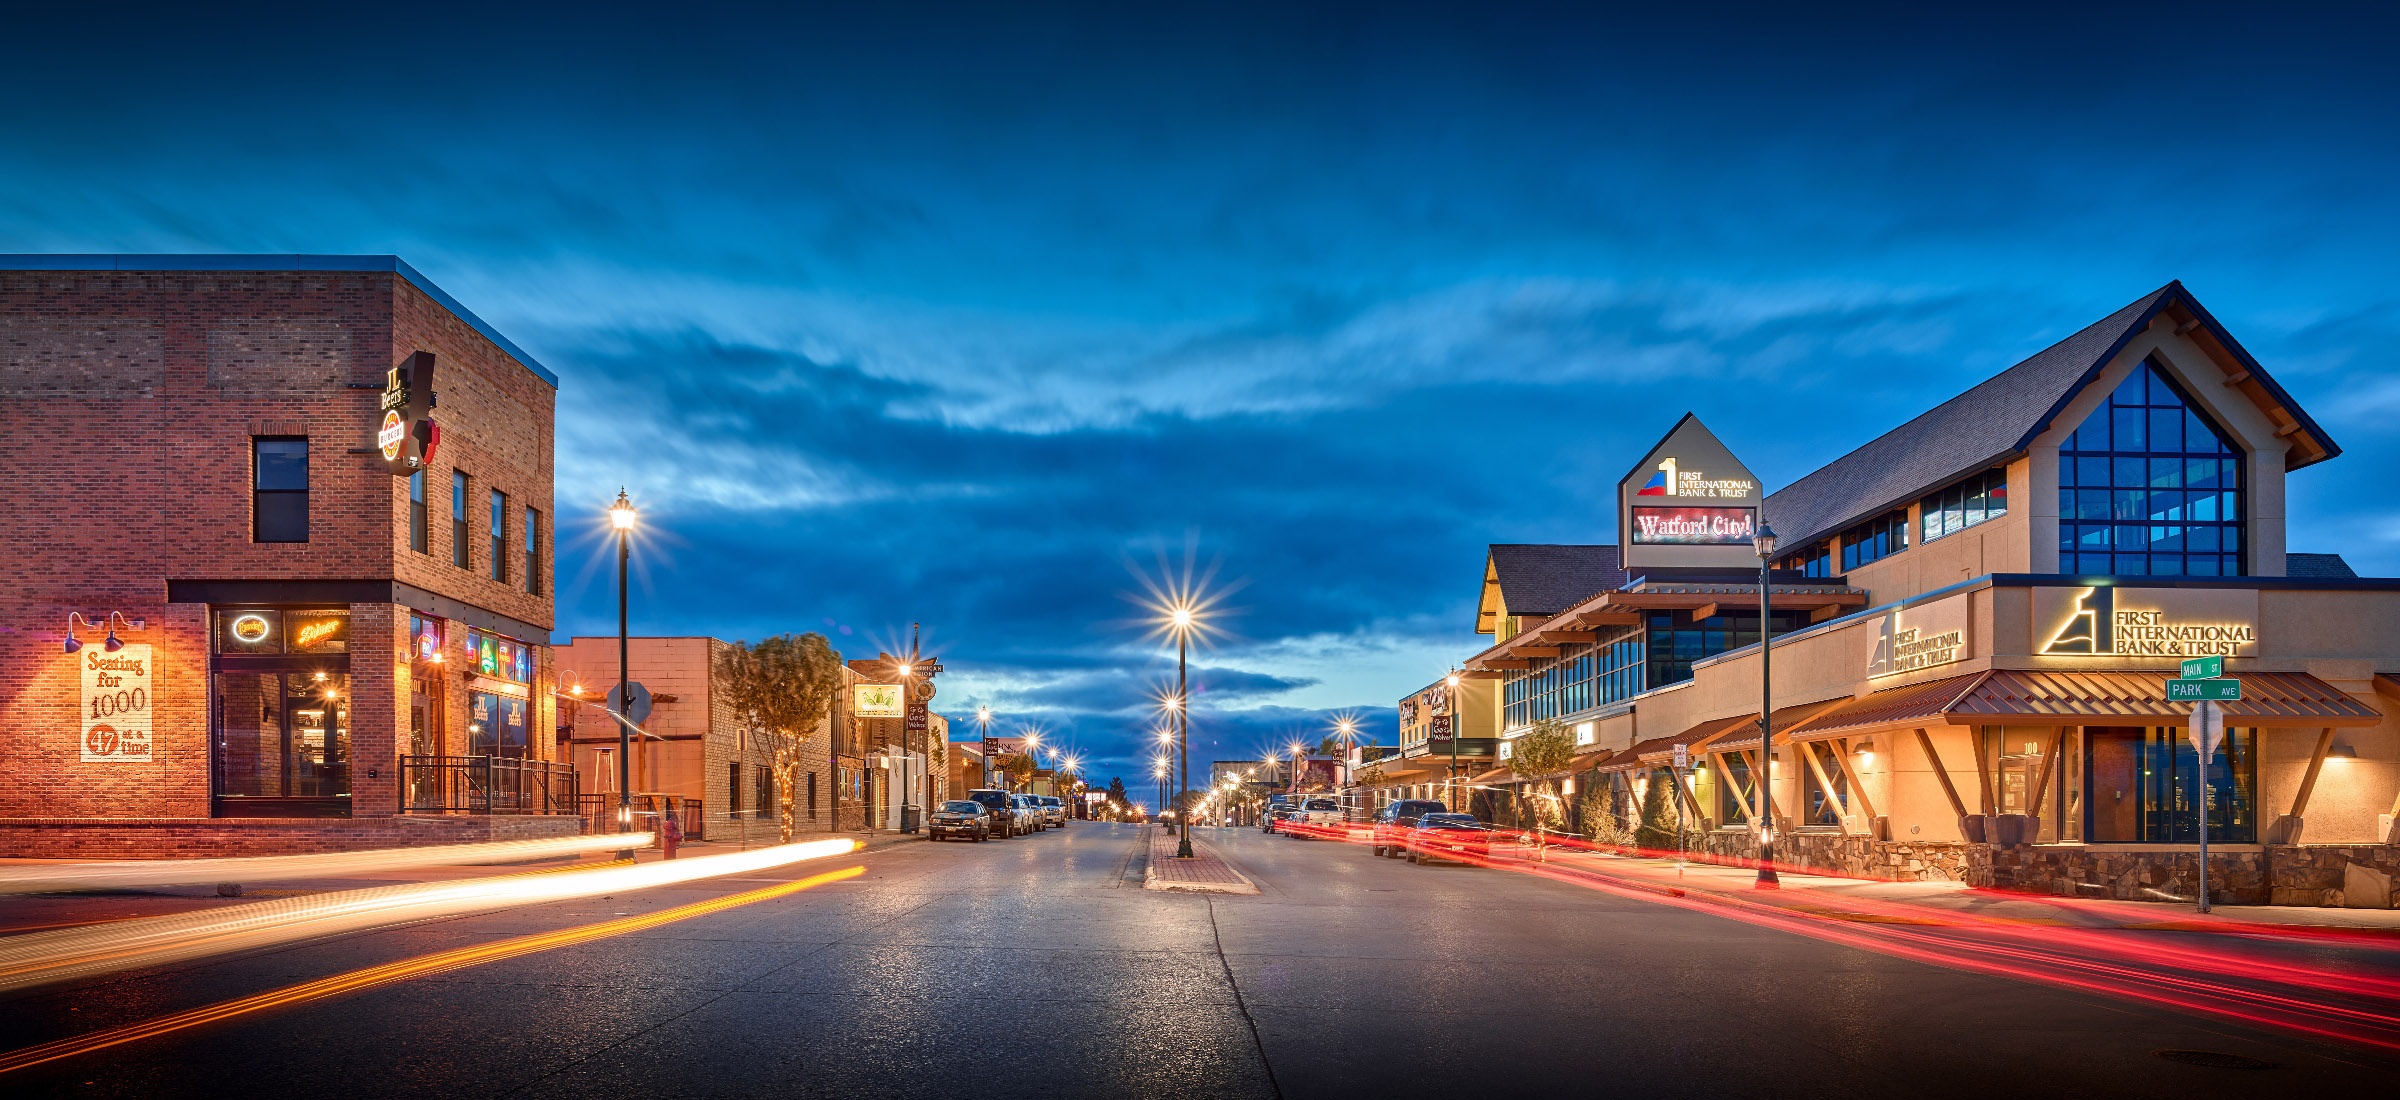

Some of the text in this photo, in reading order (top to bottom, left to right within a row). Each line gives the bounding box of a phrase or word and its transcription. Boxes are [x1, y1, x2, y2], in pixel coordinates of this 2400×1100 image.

[386, 368, 401, 393] JL
[381, 389, 402, 410] Beers
[1679, 472, 1702, 481] FIRST
[1679, 480, 1753, 489] INTERNATIONAL
[1679, 488, 1748, 498] BANK & TRUST
[1637, 514, 1751, 539] Watford City!
[2116, 611, 2161, 626] FIRST
[1894, 629, 1917, 646] FIRST
[2116, 626, 2255, 641] INTERNATIONAL
[1894, 632, 1963, 658] INTERNATIONAL
[2116, 641, 2240, 655] BANK & TRUST
[88, 651, 145, 676] Seating
[1894, 656, 1917, 671] BANK
[1926, 648, 1955, 666] TRUST
[2183, 664, 2202, 677] MAIN
[97, 672, 122, 688] for
[2172, 684, 2236, 696] PARK AVE
[91, 688, 145, 720] 1000
[122, 729, 144, 739] at a
[1433, 725, 1443, 734] Go
[90, 730, 115, 753] 47
[121, 741, 150, 755] time
[2024, 741, 2038, 755] 100
